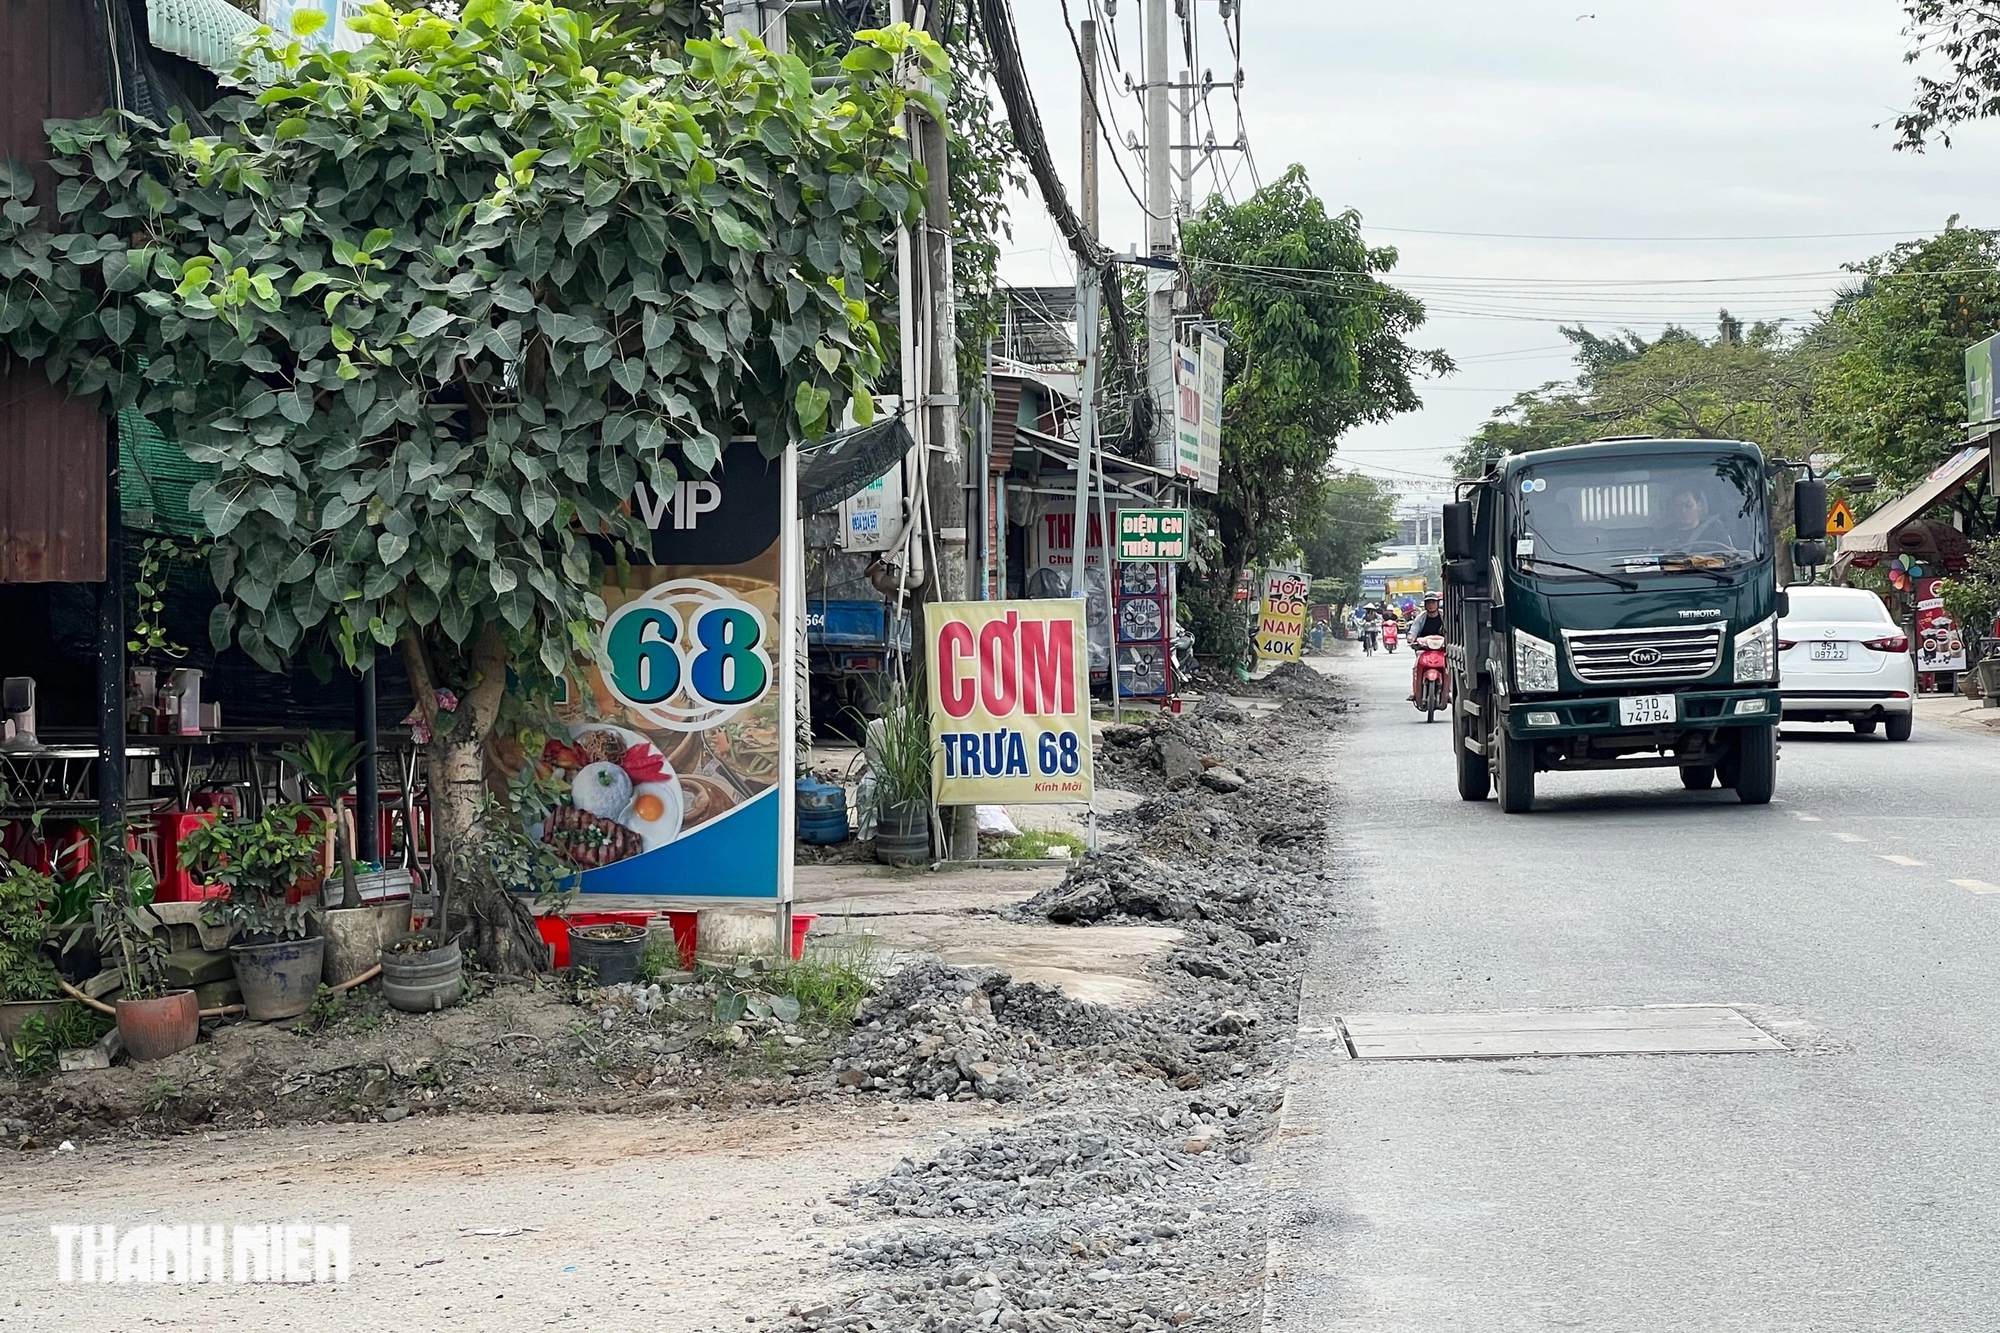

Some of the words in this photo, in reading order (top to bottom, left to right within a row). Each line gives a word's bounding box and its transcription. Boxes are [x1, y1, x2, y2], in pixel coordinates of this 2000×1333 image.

[634, 480, 722, 530] VIP
[1161, 516, 1182, 534] CN
[1262, 618, 1301, 637] NAM
[605, 606, 767, 705] 68
[1263, 639, 1295, 656] 40K
[1814, 651, 1844, 659] 097.22
[938, 609, 1077, 718] CƠM
[1633, 652, 1657, 662] TMT
[1635, 698, 1659, 711] 51D
[1627, 709, 1669, 723] 747.84
[940, 727, 1029, 777] TRƯA
[1038, 731, 1080, 775] 68
[1034, 781, 1058, 792] Kính
[1061, 781, 1082, 792] Mời
